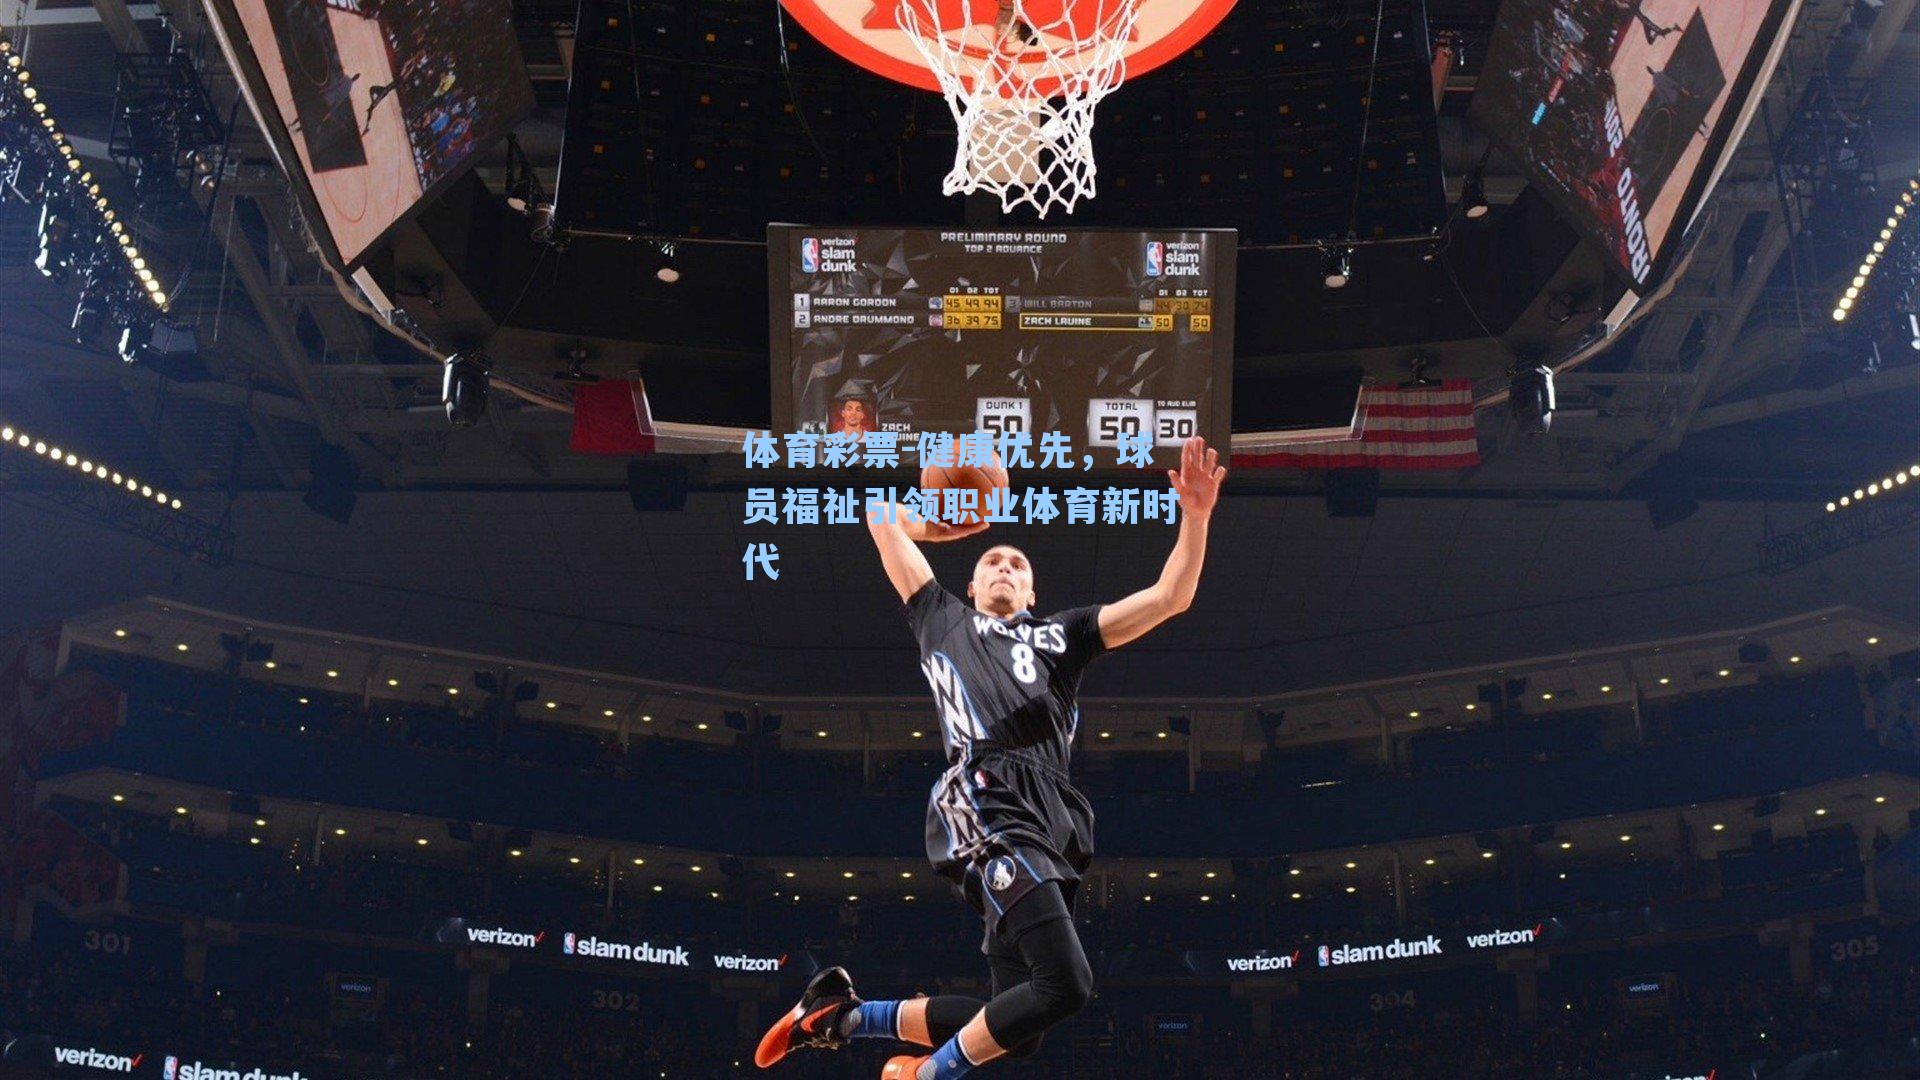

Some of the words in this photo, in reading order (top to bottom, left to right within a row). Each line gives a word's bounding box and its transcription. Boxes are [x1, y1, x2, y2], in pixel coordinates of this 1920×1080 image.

[821, 237, 855, 246] verizon
[941, 232, 1021, 242] PRELIMINARY
[1025, 233, 1067, 243] ROUND
[965, 244, 984, 253] TOP
[986, 245, 993, 253] 2
[1165, 241, 1199, 250] verizon
[821, 246, 855, 259] slam
[1165, 250, 1199, 263] slam
[821, 259, 856, 272] dunk
[1165, 263, 1200, 276] dunk
[984, 286, 999, 294] TOT
[813, 298, 849, 307] AARON
[853, 298, 897, 307] GORDON
[947, 299, 960, 308] 45
[966, 299, 980, 308] 49
[984, 299, 999, 308] 94
[813, 315, 849, 324] ANDRE
[852, 315, 915, 324] DRUMMOND
[966, 316, 980, 325] 39
[985, 316, 999, 326] 75
[1024, 317, 1052, 325] ZACH
[1156, 318, 1170, 327] 50
[1193, 318, 1208, 327] 50
[986, 401, 1015, 410] DUNK
[1105, 402, 1138, 411] TOTAL
[881, 423, 911, 432] ZACH
[983, 415, 1023, 440] 50
[1100, 416, 1141, 441] 50
[1160, 419, 1193, 439] 30
[1011, 643, 1037, 684] 8
[85, 930, 131, 955] 301
[467, 927, 535, 948] verizon
[1466, 929, 1534, 949] verizon
[576, 936, 631, 960] slam
[633, 941, 690, 967] dunk
[1331, 945, 1383, 965] slam
[1385, 934, 1442, 959] dunk
[1830, 934, 1879, 962] 305
[714, 954, 779, 971] verizon
[1227, 954, 1292, 972] verizon
[340, 983, 371, 993] verizon
[1628, 982, 1660, 992] verizon
[591, 988, 639, 1012] 302
[54, 1046, 132, 1072] verizon
